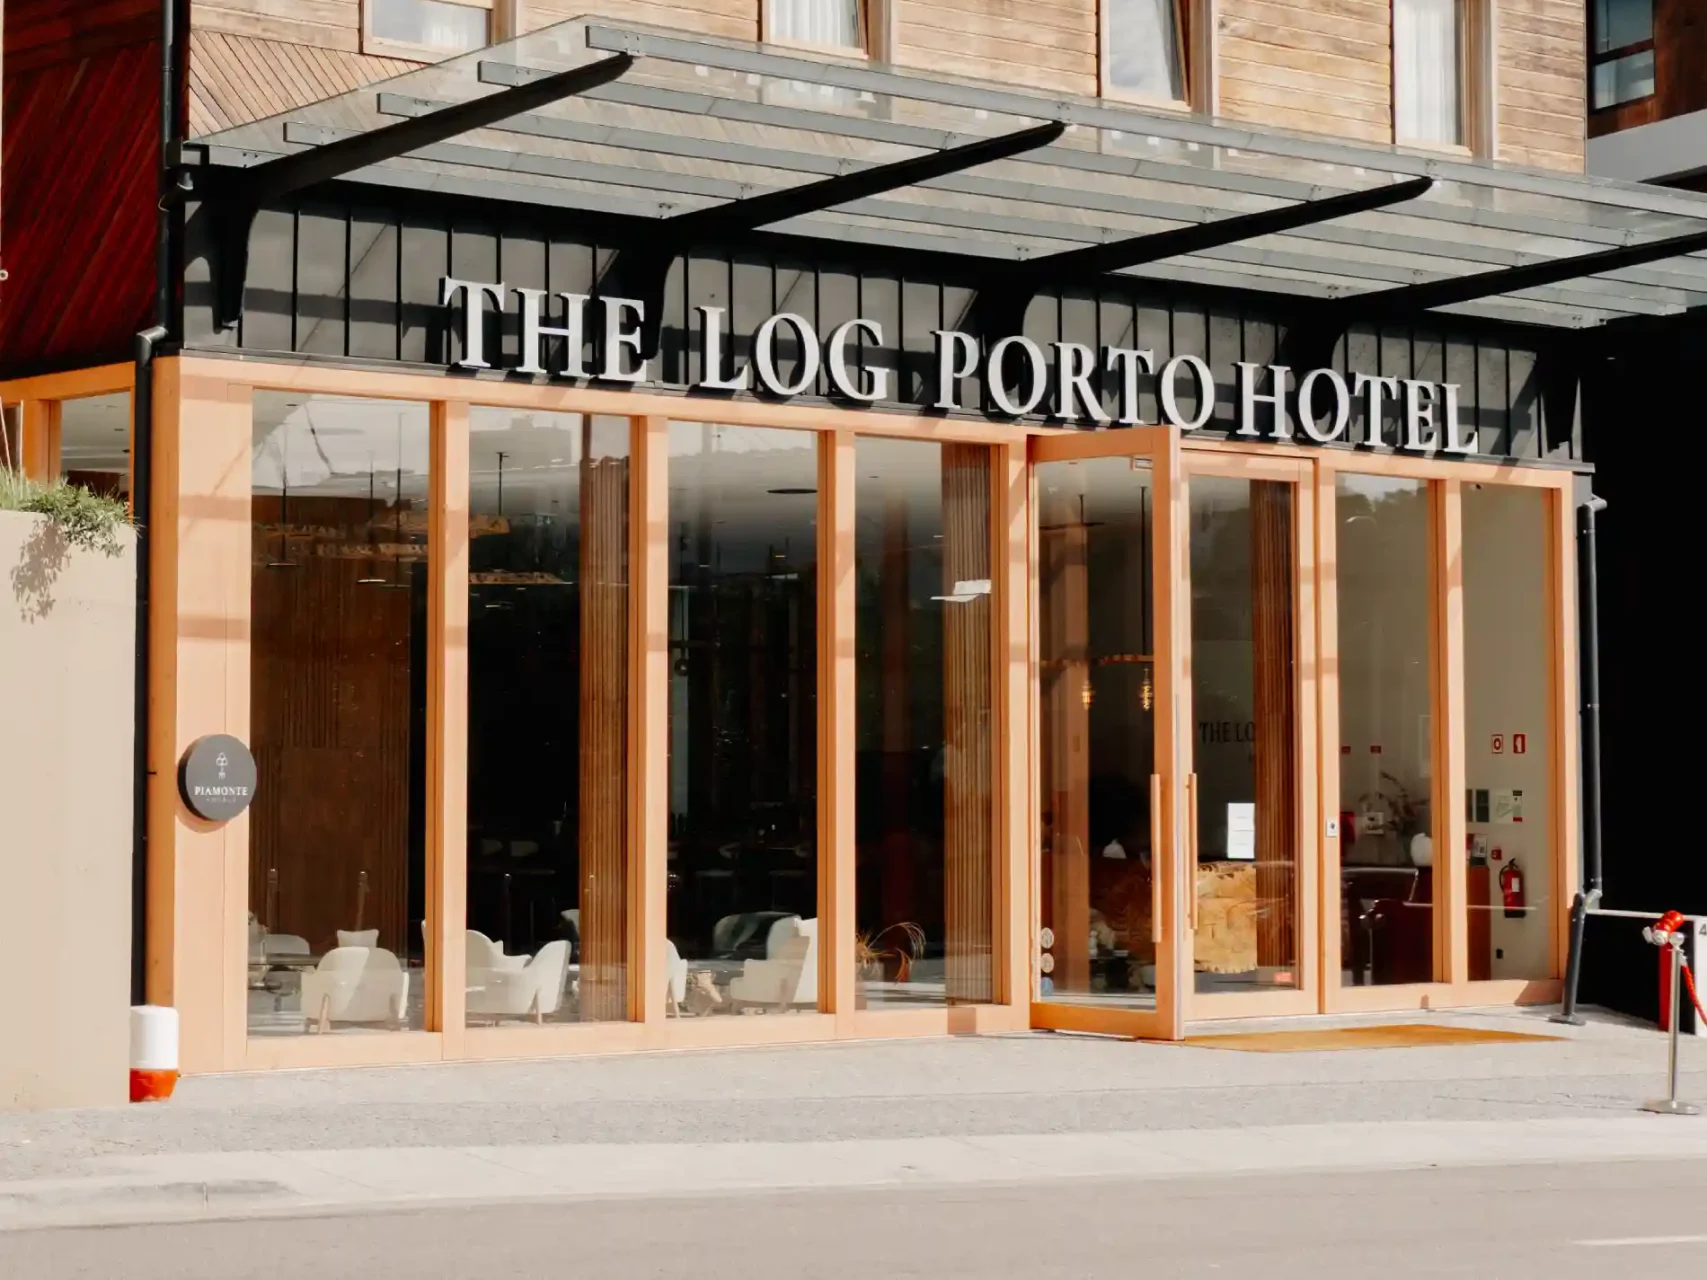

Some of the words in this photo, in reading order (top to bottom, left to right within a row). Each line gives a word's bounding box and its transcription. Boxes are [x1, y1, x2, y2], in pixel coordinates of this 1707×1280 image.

[440, 276, 647, 383] THE
[694, 305, 890, 401] LOG
[933, 329, 1215, 430] PORTO
[1235, 360, 1479, 454] HOTEL
[1199, 721, 1230, 743] THE
[194, 785, 249, 796] PIAMONTE
